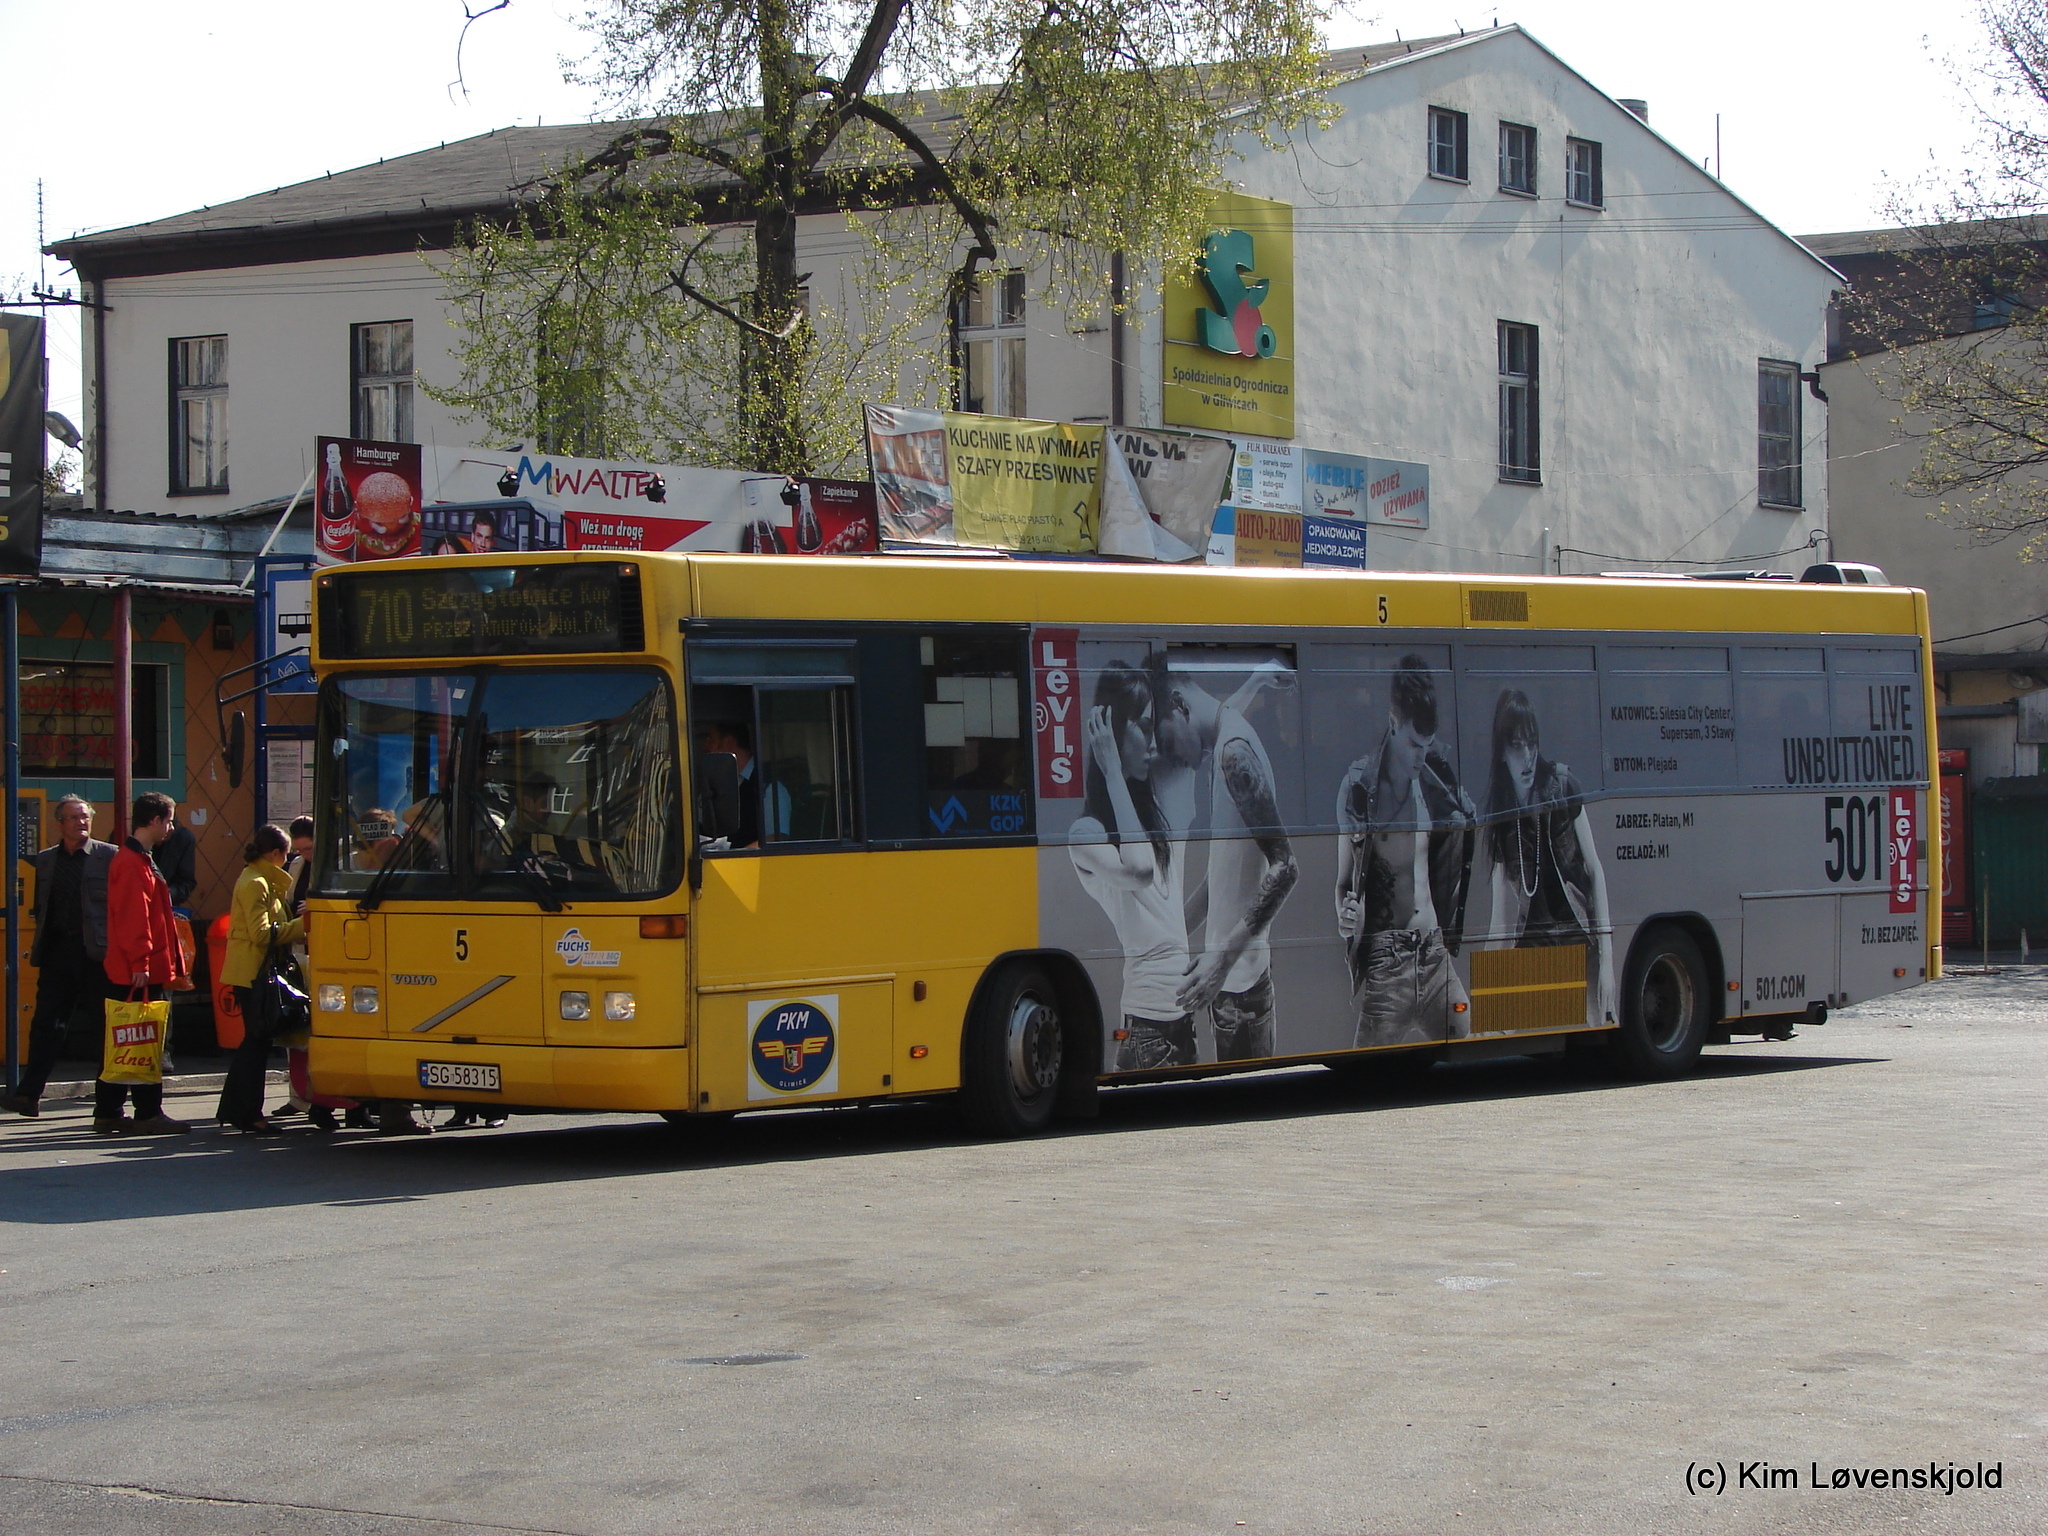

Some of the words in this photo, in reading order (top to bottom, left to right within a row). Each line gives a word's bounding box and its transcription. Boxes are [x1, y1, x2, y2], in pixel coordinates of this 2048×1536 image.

[1172, 366, 1231, 388] Spółdzielnia
[1233, 375, 1288, 395] Ogrodnicza
[1201, 393, 1210, 405] w
[1212, 392, 1258, 411] Gliwicach
[949, 427, 1012, 452] KUCHNIE
[1015, 434, 1035, 454] NA
[356, 446, 400, 462] Hamburger
[957, 455, 1001, 477] SZAFY
[1279, 461, 1293, 469] opon
[517, 456, 666, 503] McWALTE
[1306, 463, 1364, 489] MEBLE
[1370, 469, 1401, 500] ODZIEŻ
[823, 485, 858, 498] Zapiekanka
[1383, 487, 1425, 517] UŻYWANA
[580, 517, 600, 536] Weź
[601, 524, 614, 536] na
[616, 520, 644, 540] drogę
[981, 514, 1008, 523] GLIWICE
[1010, 515, 1027, 524] PLAC
[1236, 513, 1301, 543] AUTO-RADIO
[1308, 525, 1361, 542] OPAKOWANIA
[1305, 543, 1365, 559] JEDNORAZOWE
[360, 588, 413, 643] 710
[1378, 597, 1387, 624] 5
[1611, 706, 1658, 721] KATOWICE:
[1659, 706, 1686, 720] Silesia
[1687, 705, 1703, 722] City
[1704, 705, 1733, 721] Center,
[1868, 685, 1912, 731] LIVE
[1660, 726, 1703, 742] Supersam,
[1704, 725, 1710, 739] 3
[1711, 725, 1735, 742] Stawy
[1614, 757, 1646, 772] BYTOM:
[1647, 757, 1678, 774] Plejada
[1783, 735, 1920, 785] UNBUTTONED.
[989, 795, 1021, 811] KZK
[989, 815, 1024, 832] GOP
[1615, 813, 1651, 829] ZABRZE:
[1652, 813, 1681, 829] Platan,
[1682, 812, 1694, 827] M1
[1616, 840, 1656, 860] CZELADŹ:
[1658, 843, 1669, 858] M1
[1861, 924, 1876, 944] ŻYJ.
[1877, 926, 1891, 943] BEZ
[455, 930, 469, 961] 5
[557, 941, 590, 952] FUCHS
[391, 974, 437, 985] VOLVO
[1756, 974, 1805, 1001] 501.COM
[776, 1010, 810, 1031] PKM
[115, 1025, 155, 1043] BILLA
[114, 1048, 152, 1066] dnes
[430, 1065, 449, 1084] SG
[454, 1067, 497, 1086] 58315
